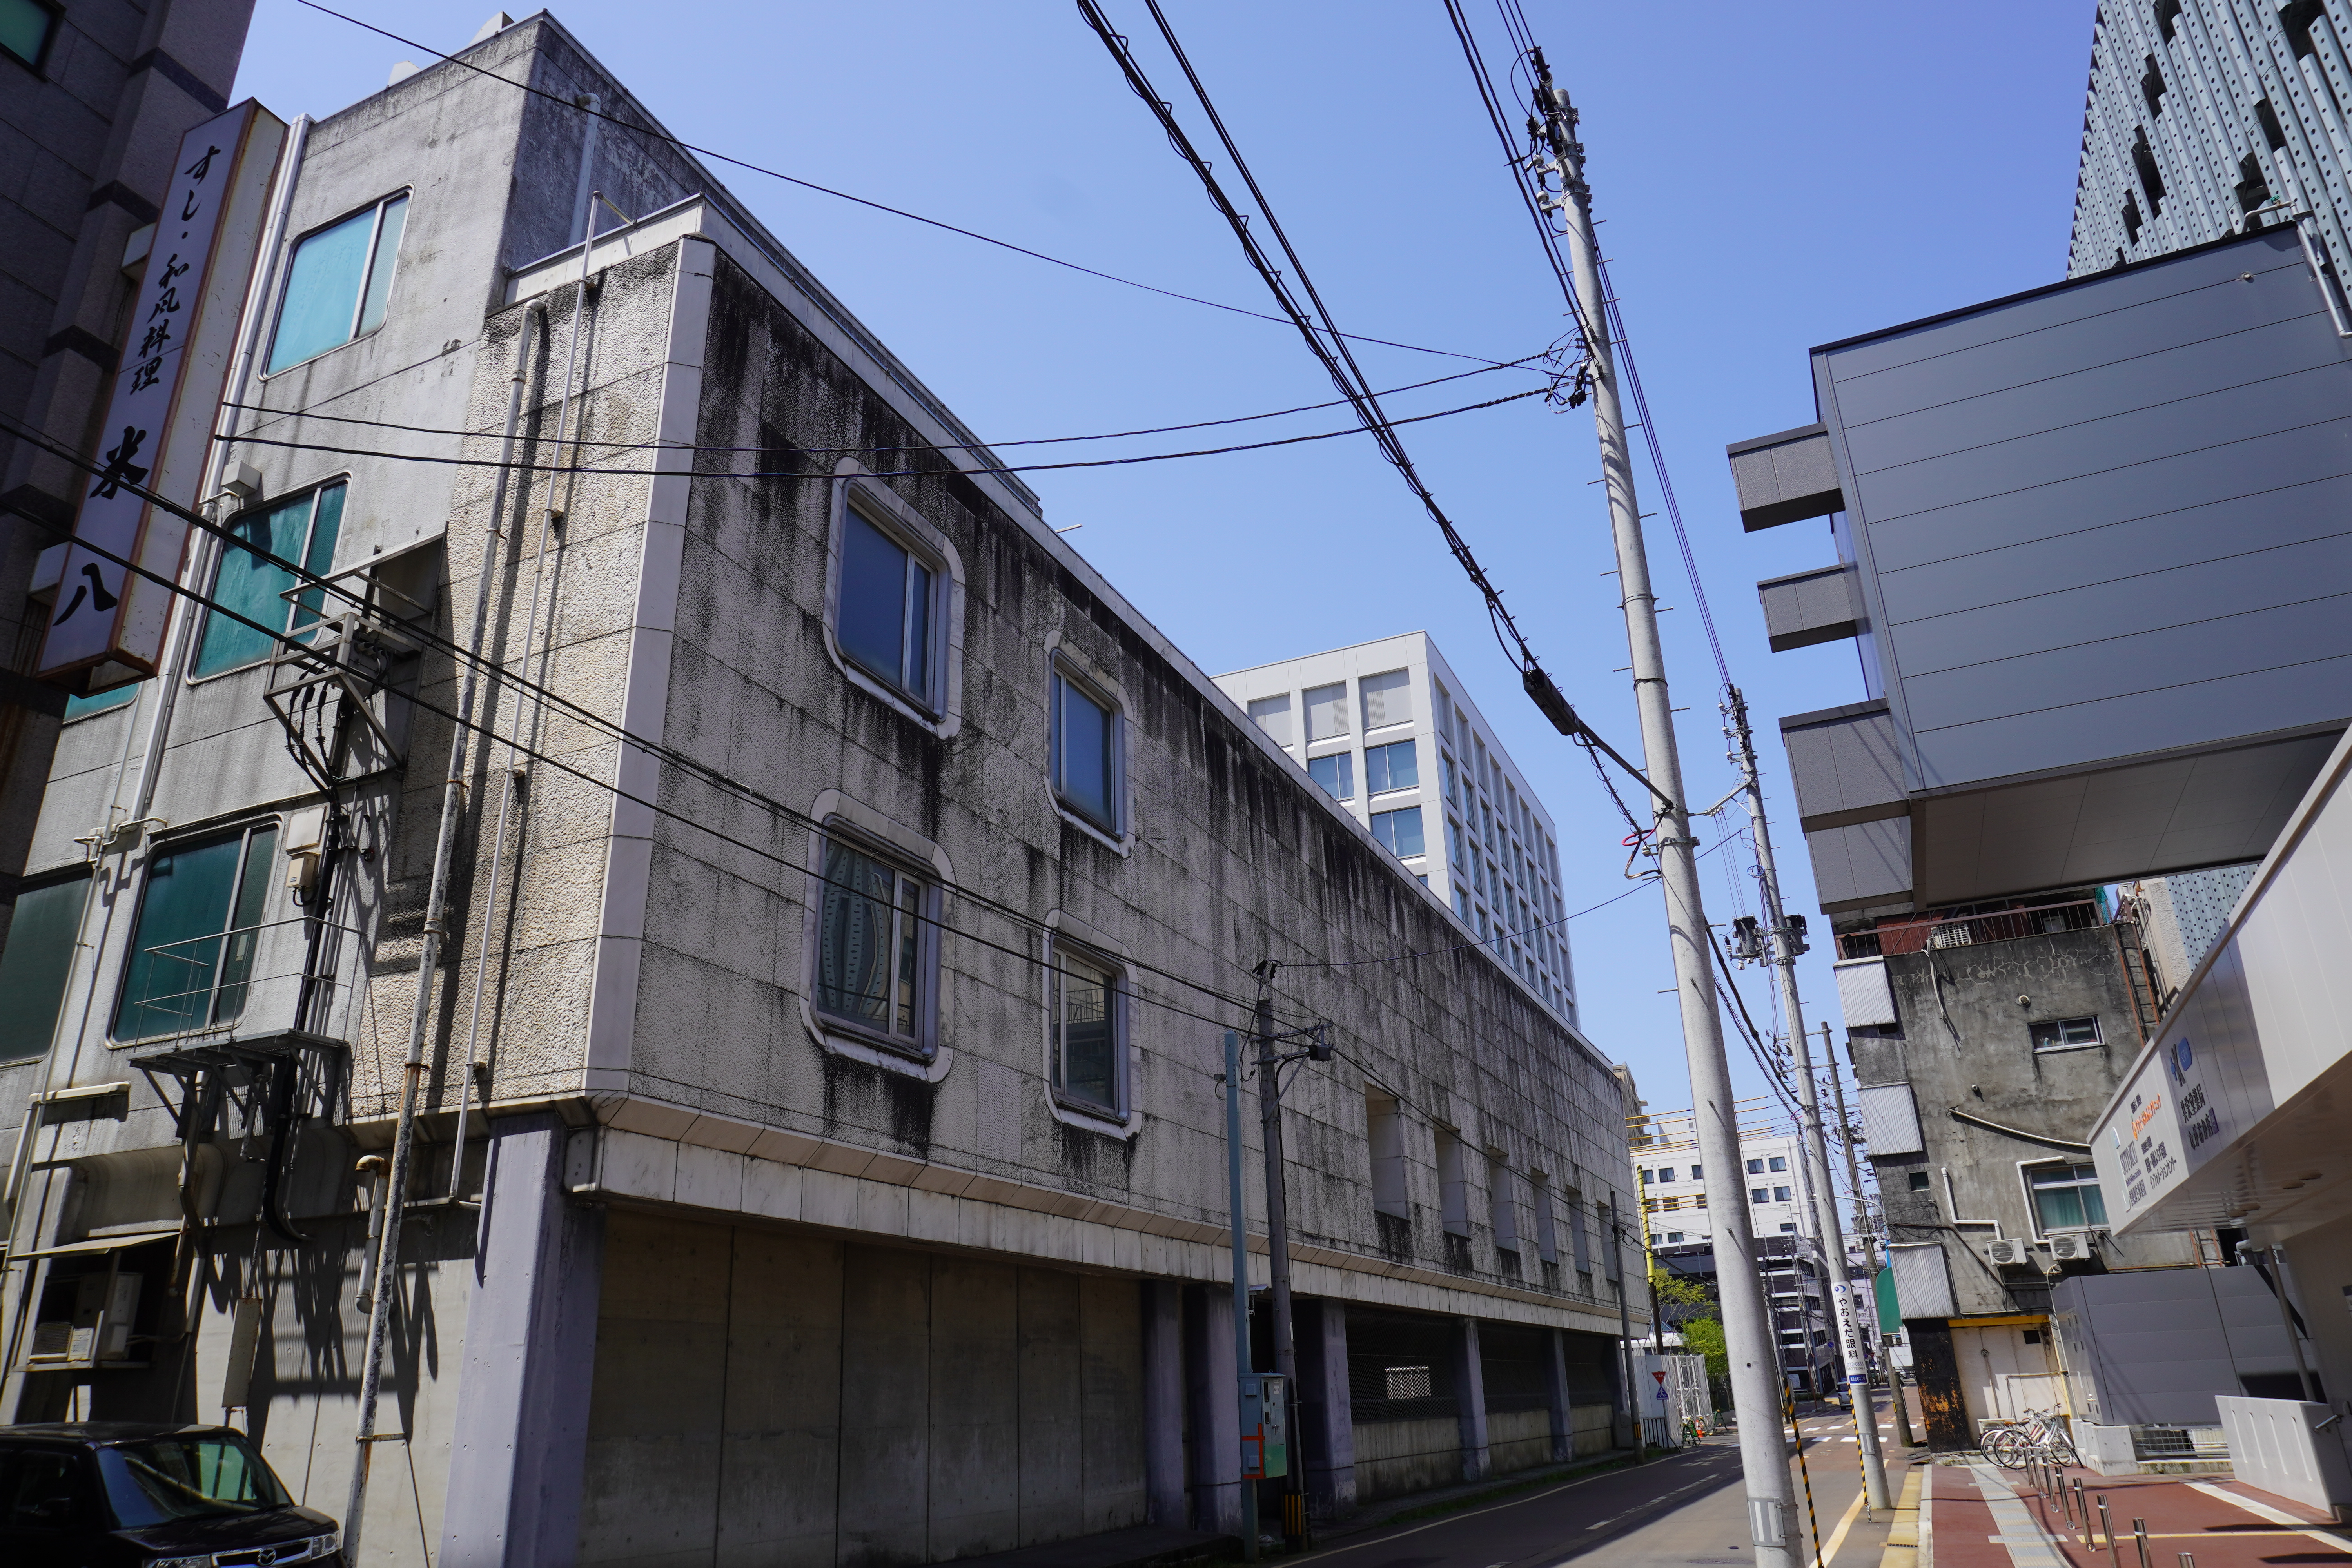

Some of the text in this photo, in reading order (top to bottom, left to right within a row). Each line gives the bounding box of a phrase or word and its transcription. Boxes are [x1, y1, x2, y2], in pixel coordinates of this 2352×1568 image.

[130, 145, 221, 396] すし・和風料理
[53, 426, 149, 626] 米八
[2120, 1140, 2138, 1176] SUTOKU
[1838, 1298, 1858, 1359] やおえだ眼科
